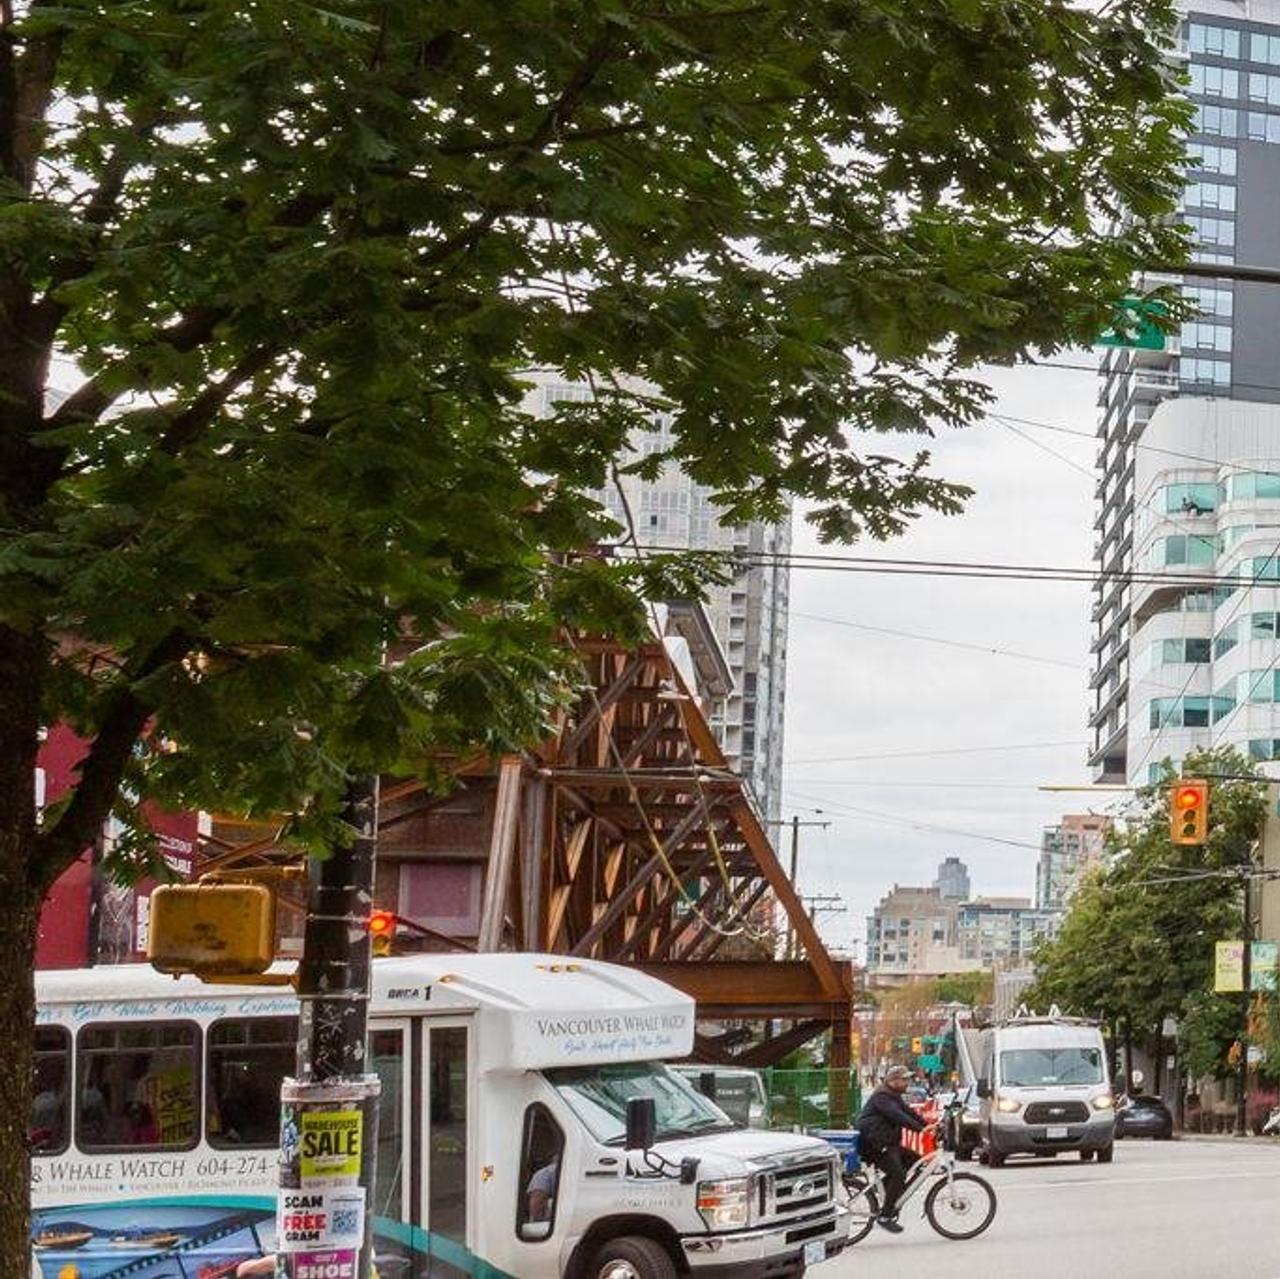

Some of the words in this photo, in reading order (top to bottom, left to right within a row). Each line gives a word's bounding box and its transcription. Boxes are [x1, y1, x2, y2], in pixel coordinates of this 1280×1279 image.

[425, 984, 432, 1000] 1
[537, 1018, 621, 1037] VANCOUVER
[303, 1130, 358, 1158] SALE
[49, 1162, 112, 1181] WHALE
[120, 1159, 185, 1178] WATCH
[284, 1195, 323, 1208] SCAN
[283, 1213, 326, 1230] FREE
[297, 1263, 352, 1279] SHOE
